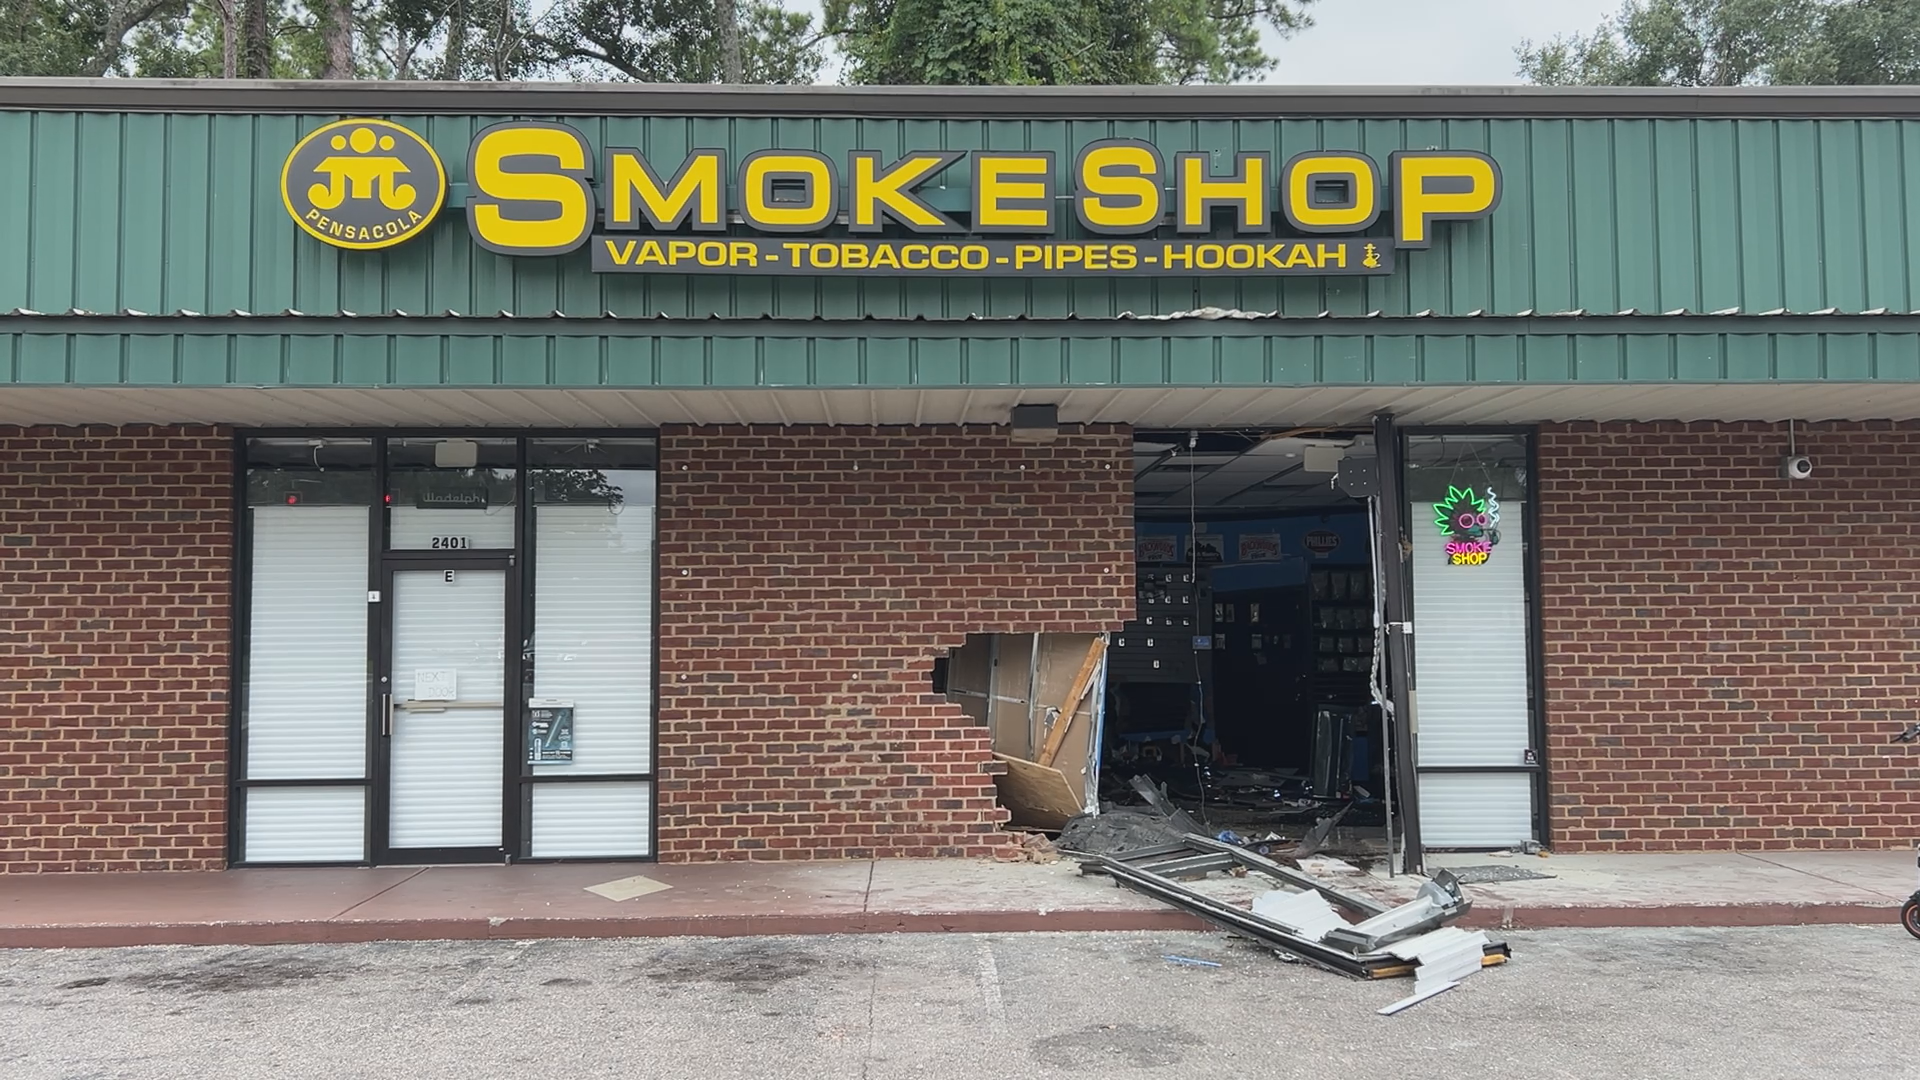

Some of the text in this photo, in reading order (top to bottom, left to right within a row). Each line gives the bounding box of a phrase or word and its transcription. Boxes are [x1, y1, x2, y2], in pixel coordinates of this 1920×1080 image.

[305, 208, 423, 241] PENSACOLA
[431, 537, 467, 549] 2401
[1306, 535, 1338, 548] PHILLIES
[1445, 541, 1493, 555] SMOKE
[1451, 552, 1488, 566] SHOP
[445, 571, 453, 582] E
[417, 671, 447, 683] NEXT
[428, 687, 455, 698] DOOR
